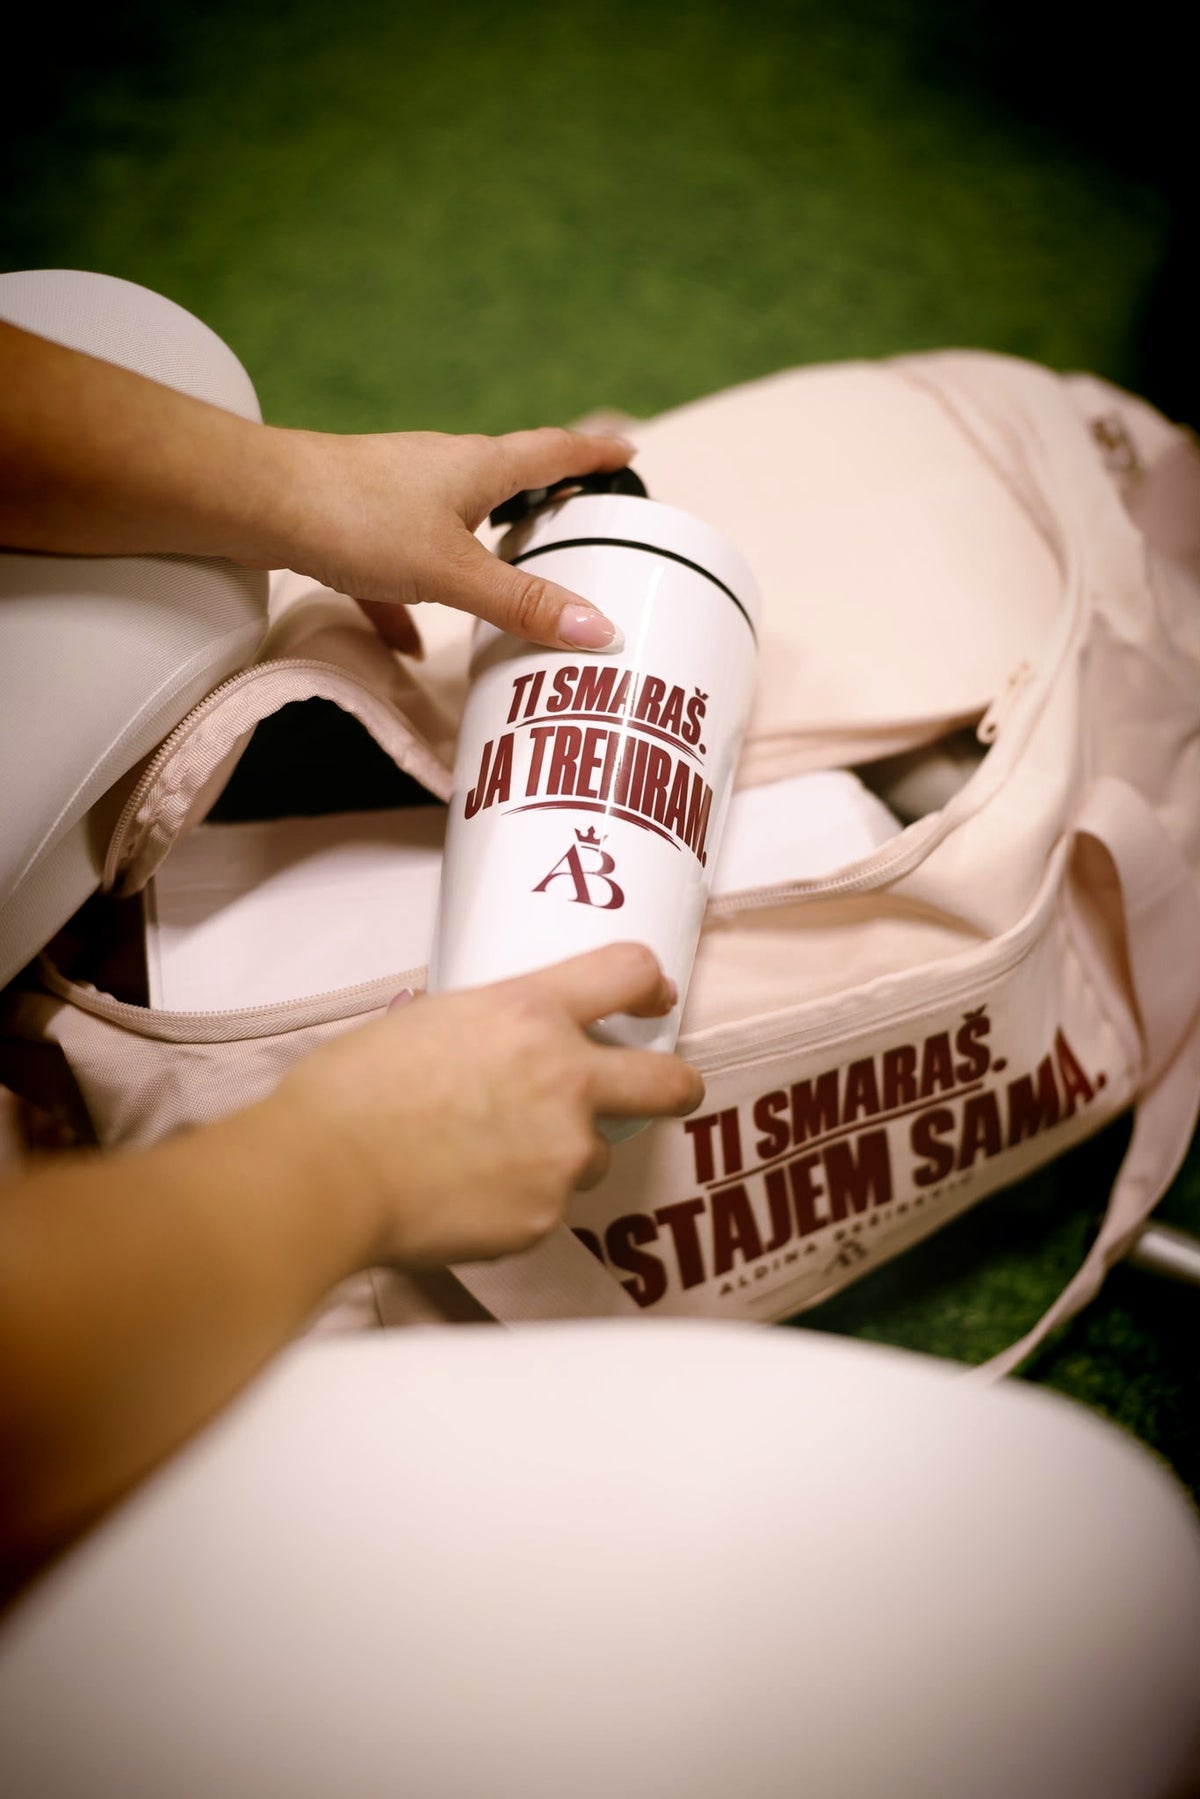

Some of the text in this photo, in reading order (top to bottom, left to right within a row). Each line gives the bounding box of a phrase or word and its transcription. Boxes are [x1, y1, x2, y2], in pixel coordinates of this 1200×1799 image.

[506, 665, 709, 755] TI SMARAŠ.
[464, 732, 515, 820] JA
[684, 1004, 1008, 1185] TI SMARAŠ.
[910, 1026, 1108, 1187] SAMA.
